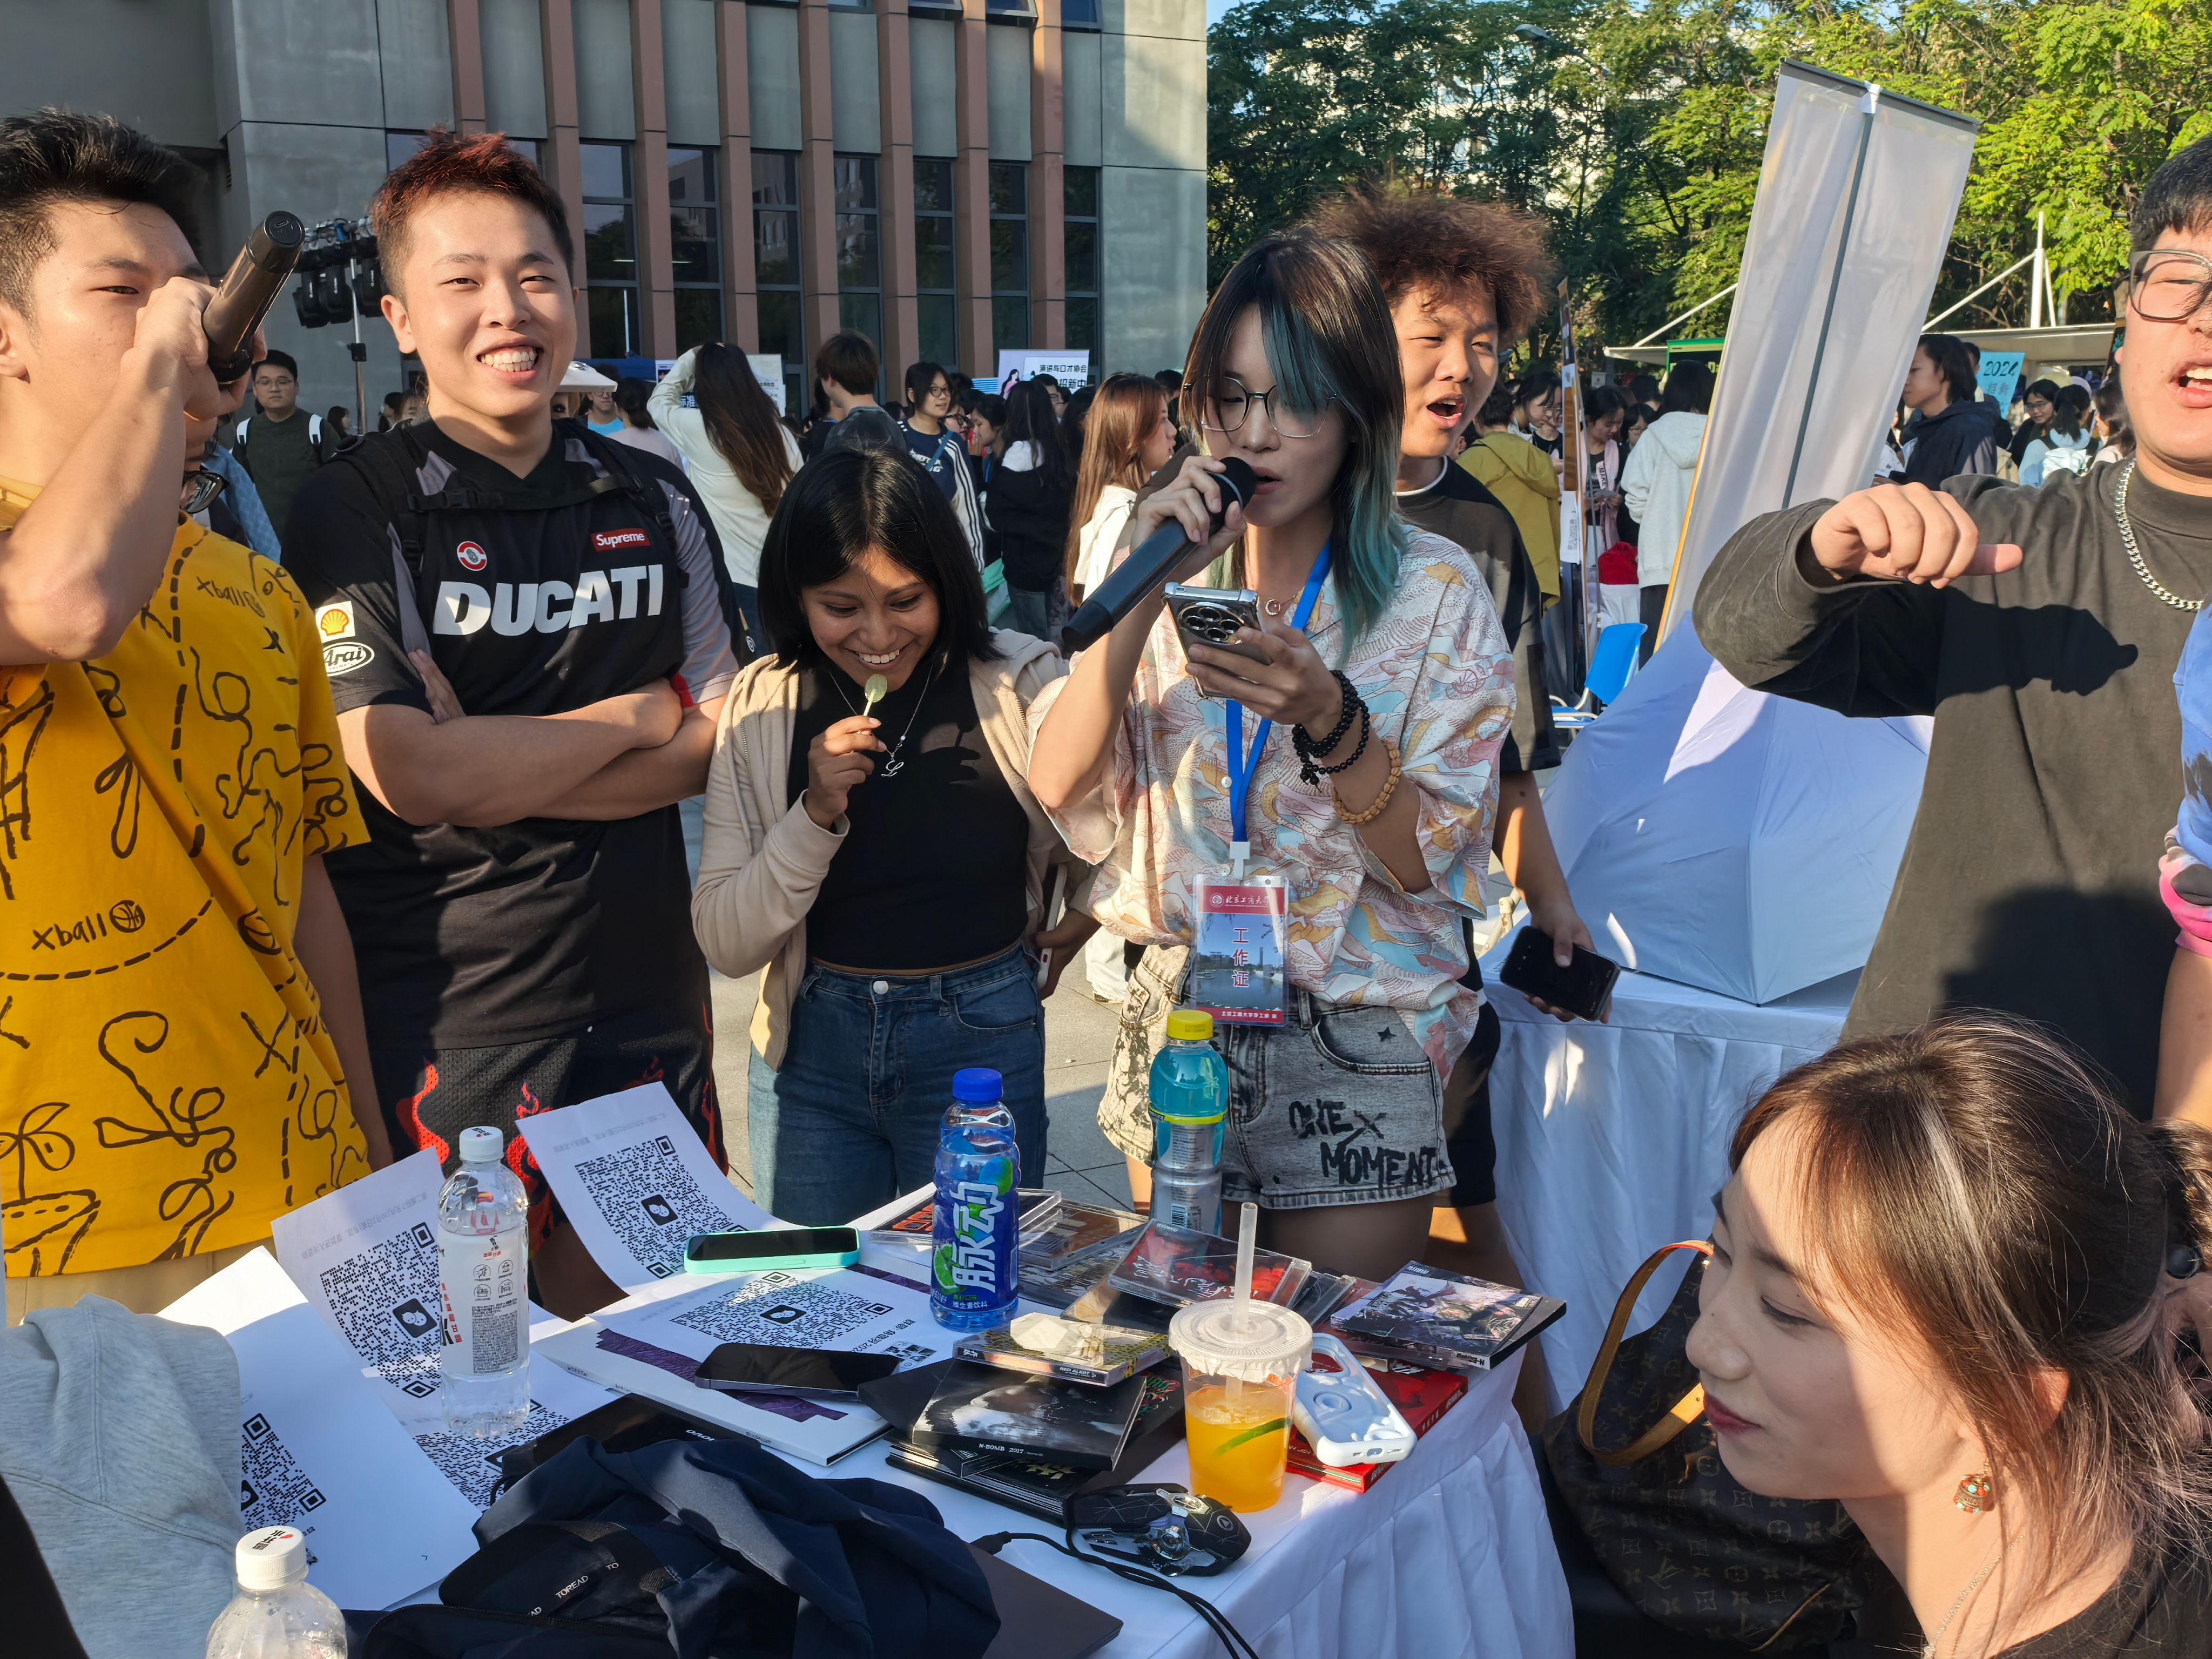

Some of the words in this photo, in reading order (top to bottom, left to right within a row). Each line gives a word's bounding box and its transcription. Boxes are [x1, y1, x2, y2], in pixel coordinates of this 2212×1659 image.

[1040, 365, 1087, 373] 演讲与口才协会
[596, 533, 645, 548] Supreme
[433, 564, 663, 636] DUCATI
[325, 646, 364, 666] Arai
[31, 913, 107, 950] xball
[1232, 927, 1250, 988] 工作证
[1320, 1141, 1438, 1188] MOMENT
[949, 1181, 1003, 1294] 脉动
[979, 1444, 1005, 1452] N-BOMB
[555, 1575, 589, 1599] TOREAD
